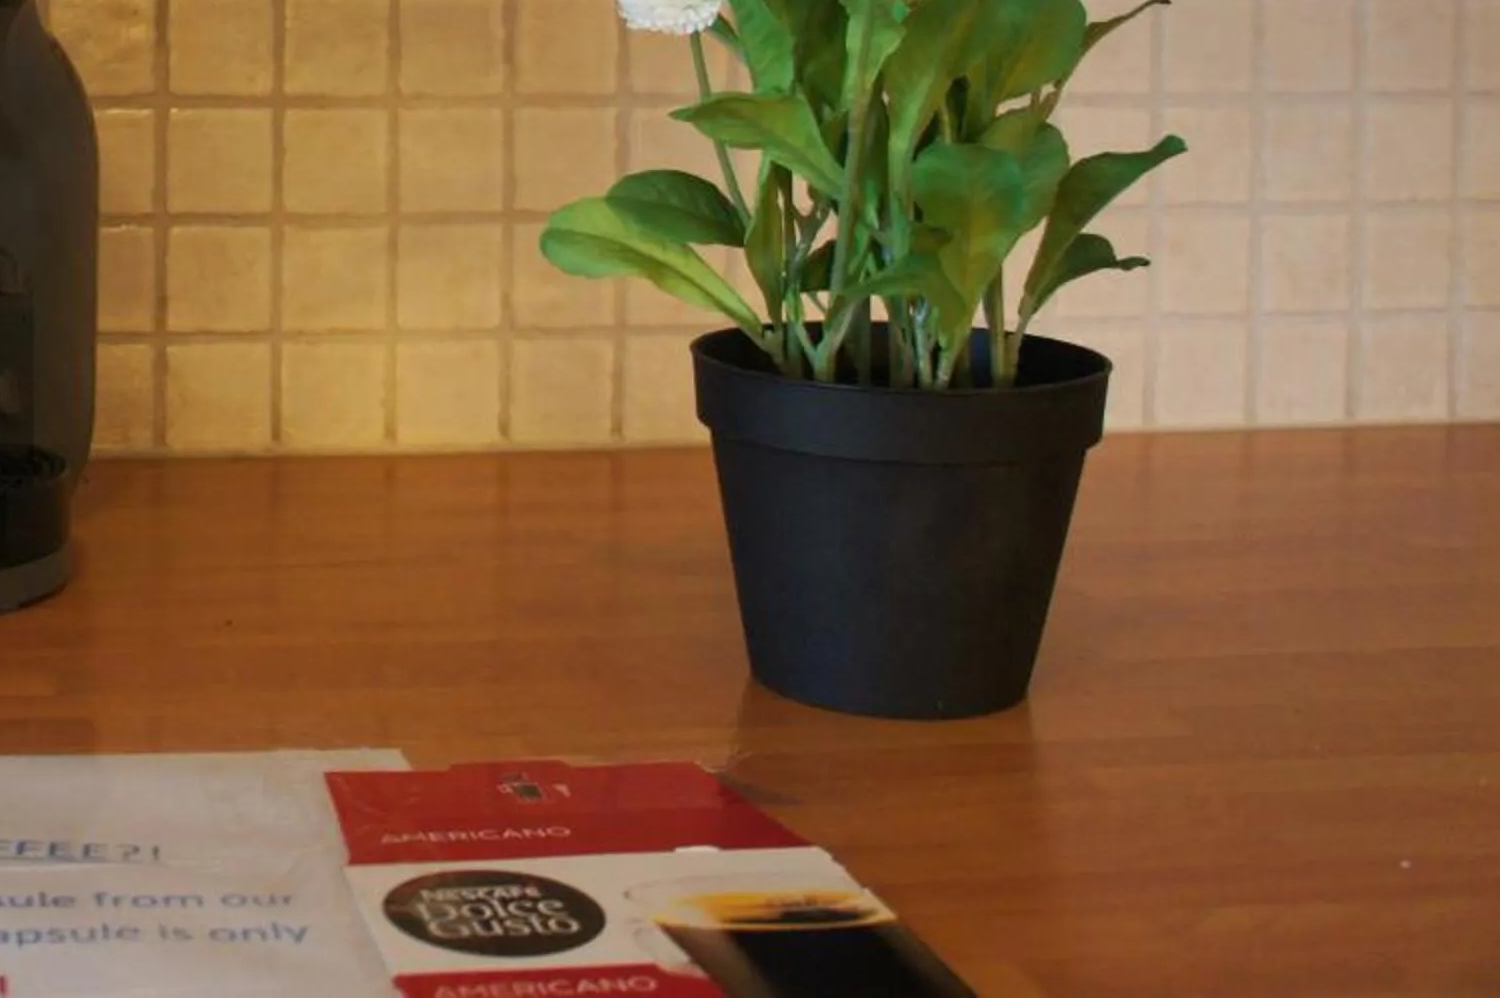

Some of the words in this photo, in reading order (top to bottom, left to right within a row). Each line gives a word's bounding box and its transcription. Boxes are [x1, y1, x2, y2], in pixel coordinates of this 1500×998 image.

[381, 826, 571, 844] AMERICANO
[94, 892, 204, 909] from
[220, 894, 293, 908] our
[417, 898, 568, 920] Dolce
[159, 924, 194, 942] is
[208, 923, 308, 944] only
[428, 914, 582, 939] Gusto
